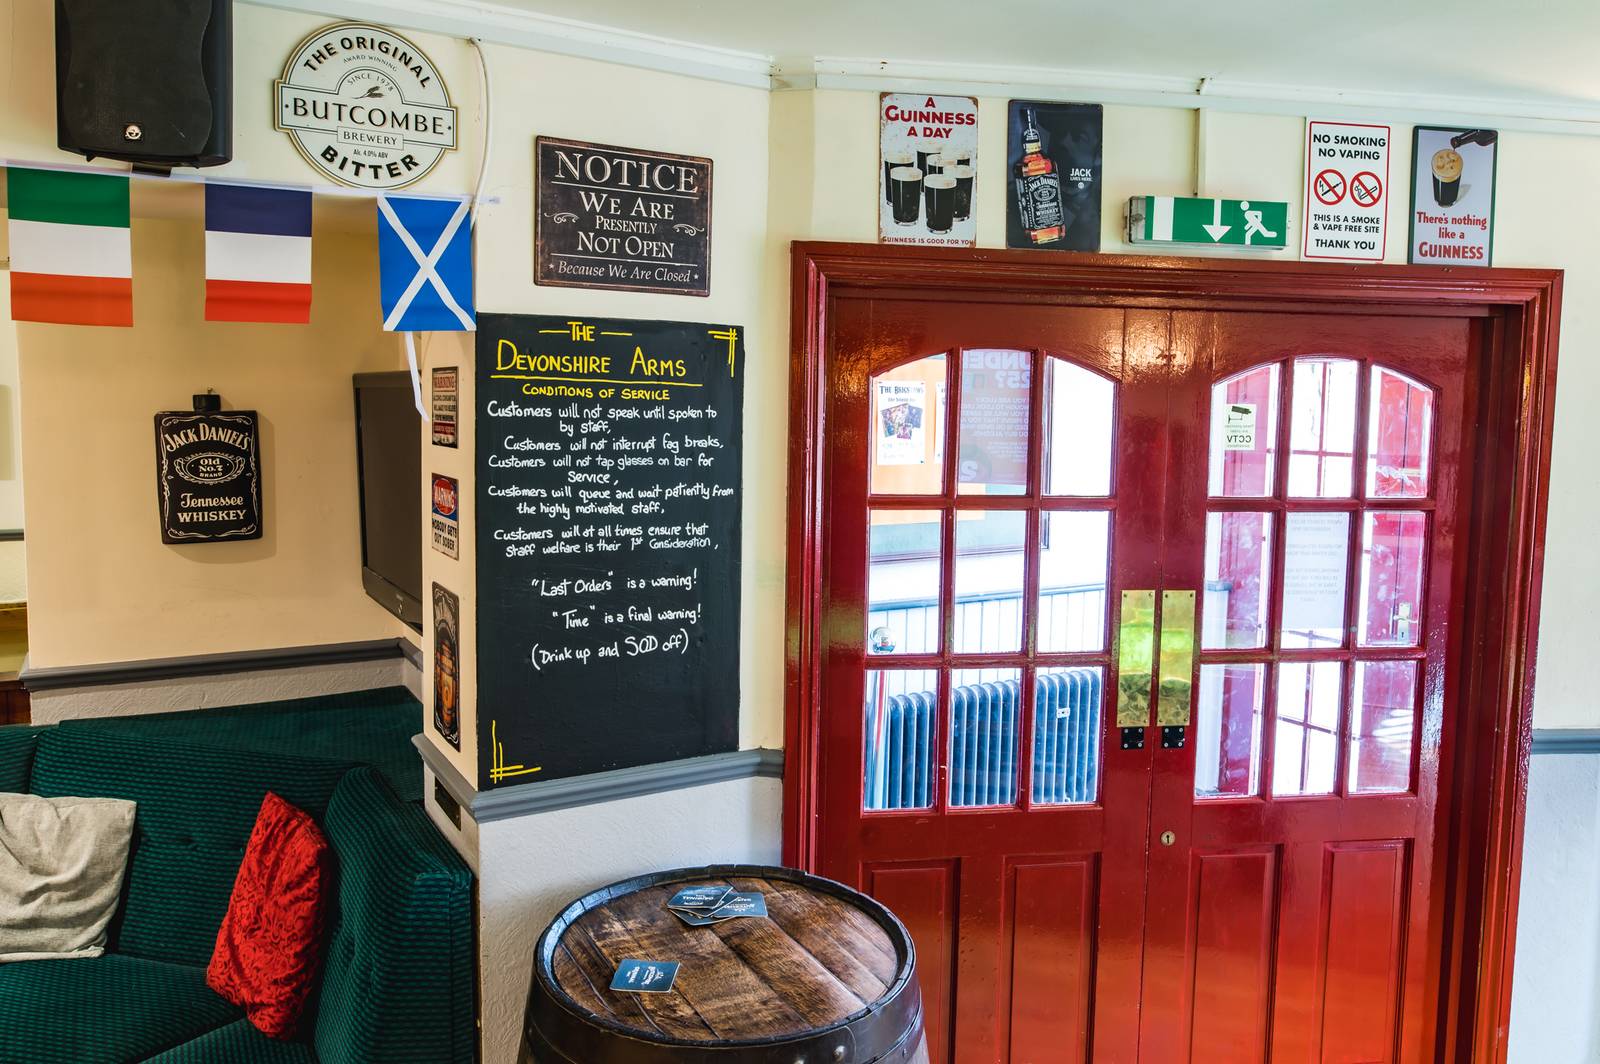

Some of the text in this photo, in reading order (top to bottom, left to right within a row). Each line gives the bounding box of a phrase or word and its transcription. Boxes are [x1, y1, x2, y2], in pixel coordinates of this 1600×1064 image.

[304, 36, 431, 88] THE ORIGINAL
[343, 55, 398, 72] AWARD WINNING
[348, 73, 393, 92] SINCE 1978
[925, 97, 936, 108] A
[293, 97, 444, 135] BUTCOMBE
[885, 105, 975, 126] GUINNESS
[343, 131, 397, 146] BREWERY
[907, 126, 952, 139] A DAY
[1313, 134, 1386, 147] NO SMOKING
[320, 145, 420, 180] BITTER
[1318, 148, 1380, 161] NO VAPING
[554, 150, 698, 193] NOTICE
[1070, 168, 1091, 177] JACK
[1313, 213, 1380, 224] THIS IS A SMOKE
[1416, 211, 1487, 230] There's nothing
[1313, 223, 1380, 233] & VAPE FREE SITE
[1438, 227, 1465, 239] like a
[882, 236, 916, 244] GUINNESS
[1315, 239, 1376, 250] THANK YOU
[1418, 242, 1484, 260] GUINNESS
[558, 261, 691, 283] Because We Are Closed
[568, 321, 595, 341] THE
[496, 339, 687, 377] DEVONSHIRE ARMS
[522, 383, 671, 400] CONDITIONS OF SERVICE
[487, 400, 718, 422] Customers will not speak until spoken to
[164, 423, 250, 452] JACK DANIEL'S
[560, 421, 574, 437] by
[504, 435, 561, 451] Customers
[570, 439, 587, 451] will
[590, 439, 608, 451] not
[612, 437, 657, 451] interrupt
[662, 433, 679, 454] fag
[488, 454, 714, 471] Customers will not tap glasses on bar for
[181, 493, 244, 508] Tennessee
[488, 483, 734, 504] Customers will queue and wait patiently from
[177, 509, 246, 522] WHISKEY
[516, 502, 536, 515] the
[540, 502, 570, 520] highly
[575, 503, 625, 515] motivated
[432, 518, 457, 538] NOBODY GETS
[493, 522, 709, 541] Customers will at all times ensure that
[442, 536, 455, 551] SOBER
[542, 541, 581, 555] welfare
[585, 542, 594, 553] is
[597, 541, 622, 552] their
[631, 537, 643, 550] 1st
[628, 579, 637, 589] is
[639, 579, 646, 588] a
[651, 568, 698, 591] warning!
[605, 612, 614, 624] is
[616, 613, 624, 623] a
[628, 606, 652, 623] final
[658, 603, 701, 625] warning!
[531, 628, 689, 671] (Drink up and SOD off)
